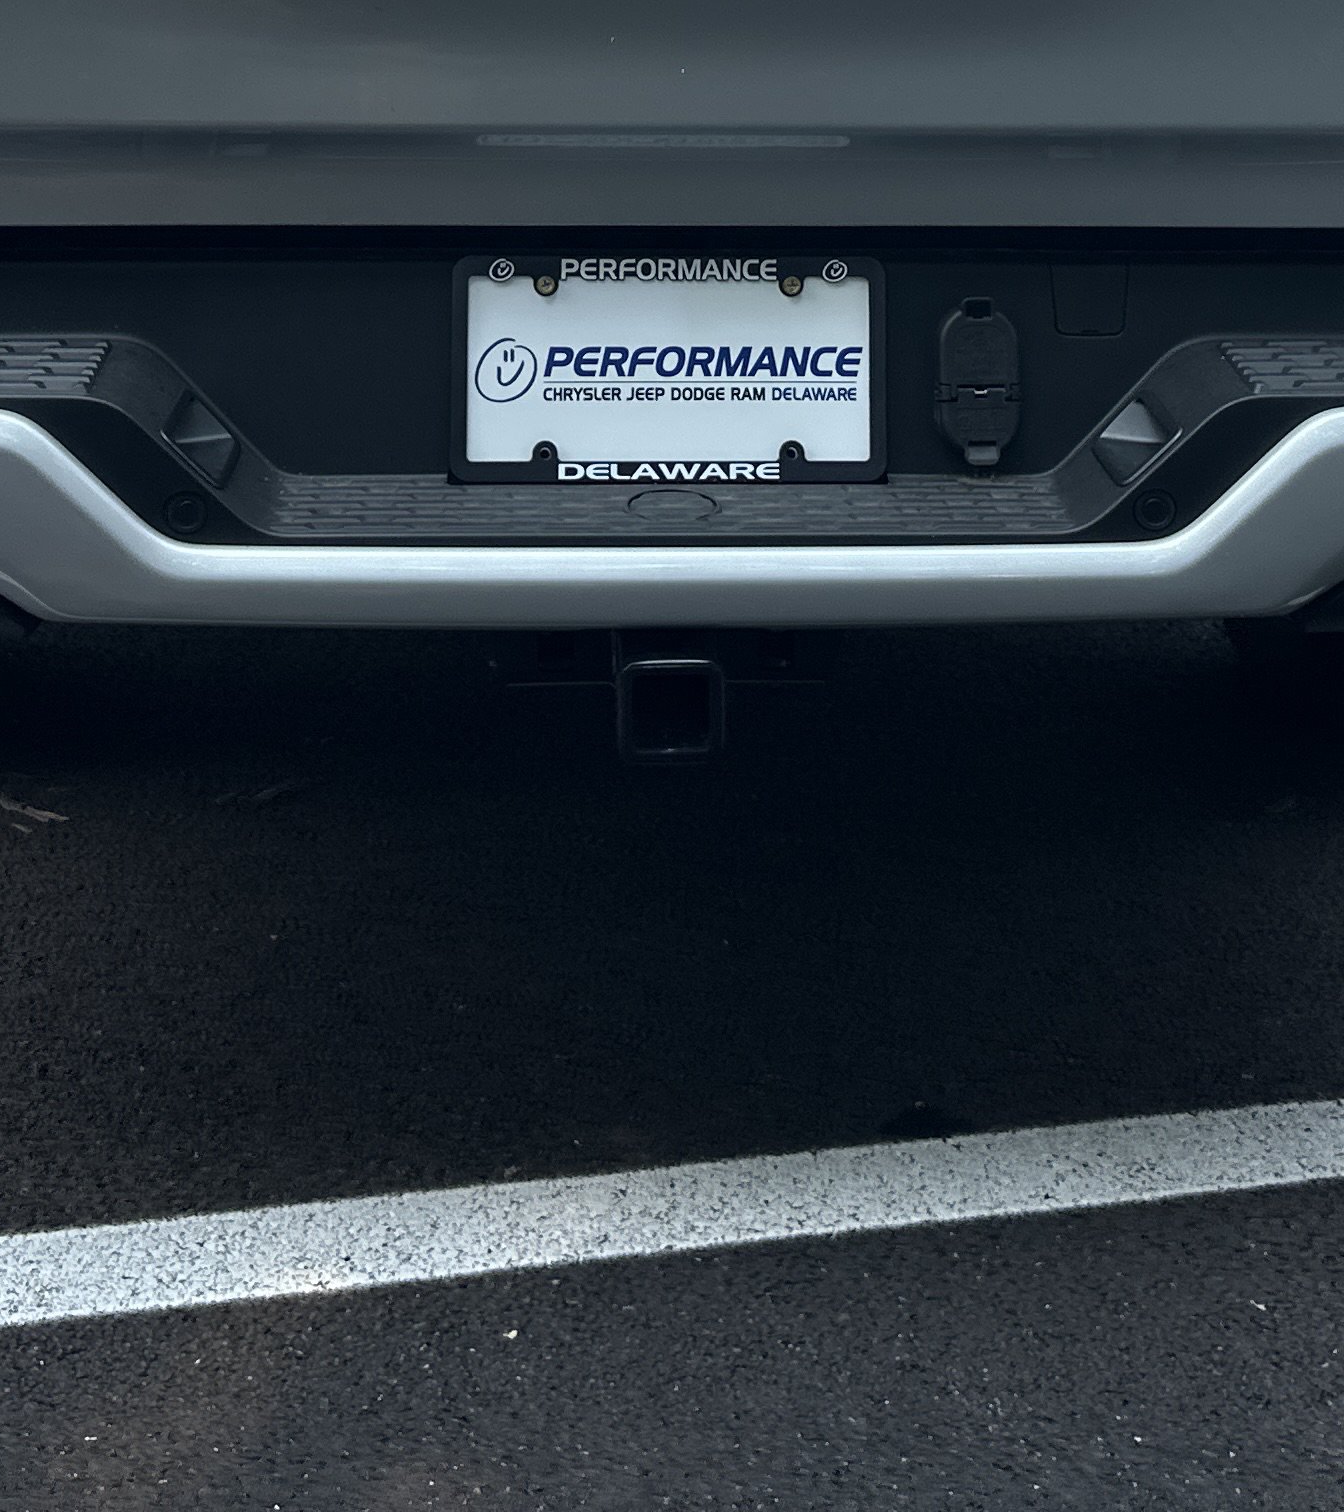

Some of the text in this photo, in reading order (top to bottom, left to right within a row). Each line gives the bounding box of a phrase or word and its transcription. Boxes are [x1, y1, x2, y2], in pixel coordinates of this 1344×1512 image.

[560, 257, 778, 281] PERFORMANCE
[543, 345, 864, 378] PERFORMANCE
[543, 386, 858, 402] CHRYSLER JEEP DODGE RAM DELAWARE
[557, 462, 781, 481] DELAWARE
